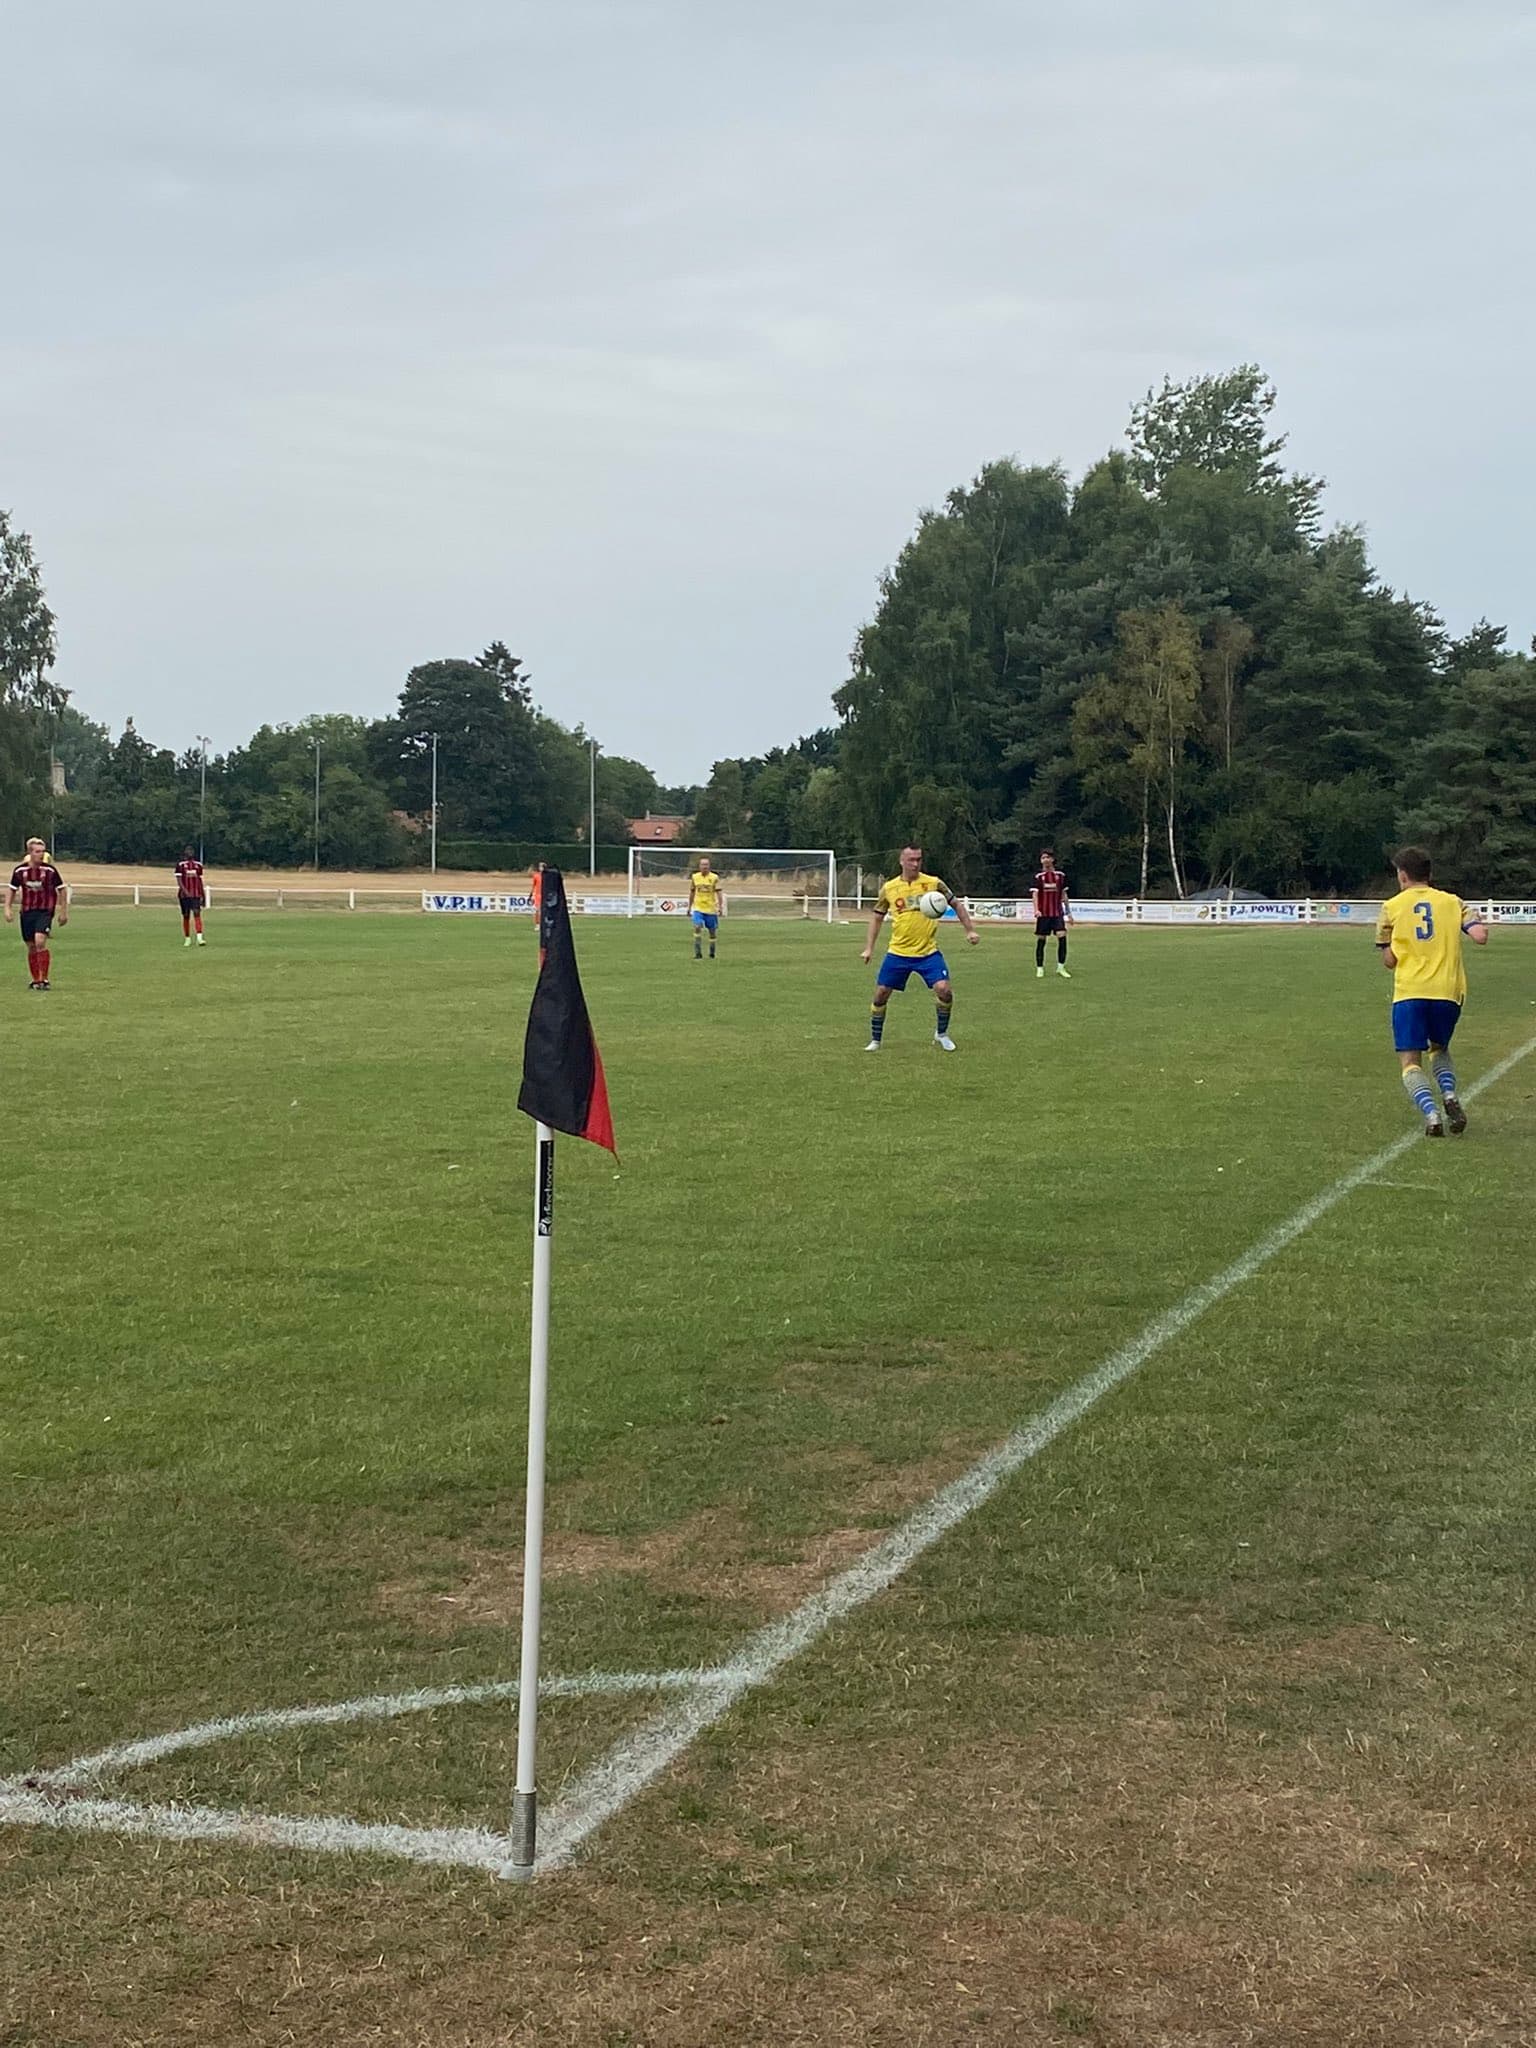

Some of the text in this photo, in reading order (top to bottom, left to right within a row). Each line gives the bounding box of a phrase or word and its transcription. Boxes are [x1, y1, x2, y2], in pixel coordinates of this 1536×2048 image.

[433, 895, 488, 910] V.P.H.
[1251, 905, 1296, 916] POWLEY
[1500, 905, 1521, 915] SKIP
[1414, 902, 1434, 942] 3
